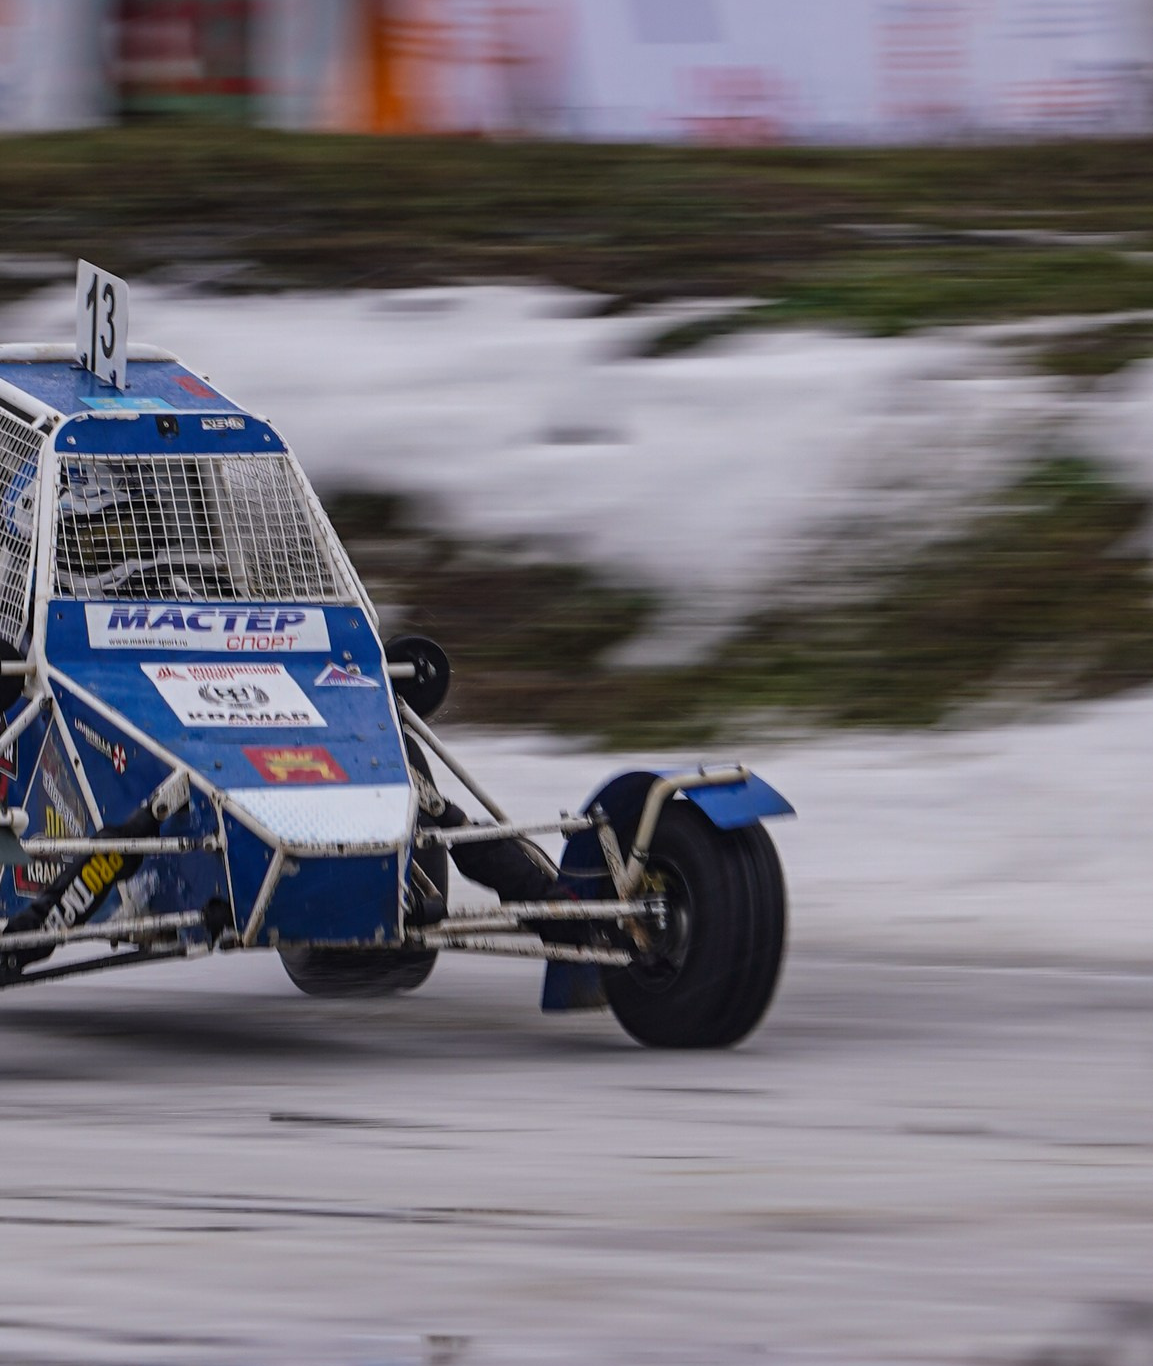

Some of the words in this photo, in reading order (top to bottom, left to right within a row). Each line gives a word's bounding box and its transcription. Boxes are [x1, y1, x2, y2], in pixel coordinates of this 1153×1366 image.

[86, 273, 116, 372] 13
[107, 608, 306, 633] МАСТЕР
[108, 637, 188, 648] www.master-sport.ru
[226, 635, 299, 651] СПОРТ
